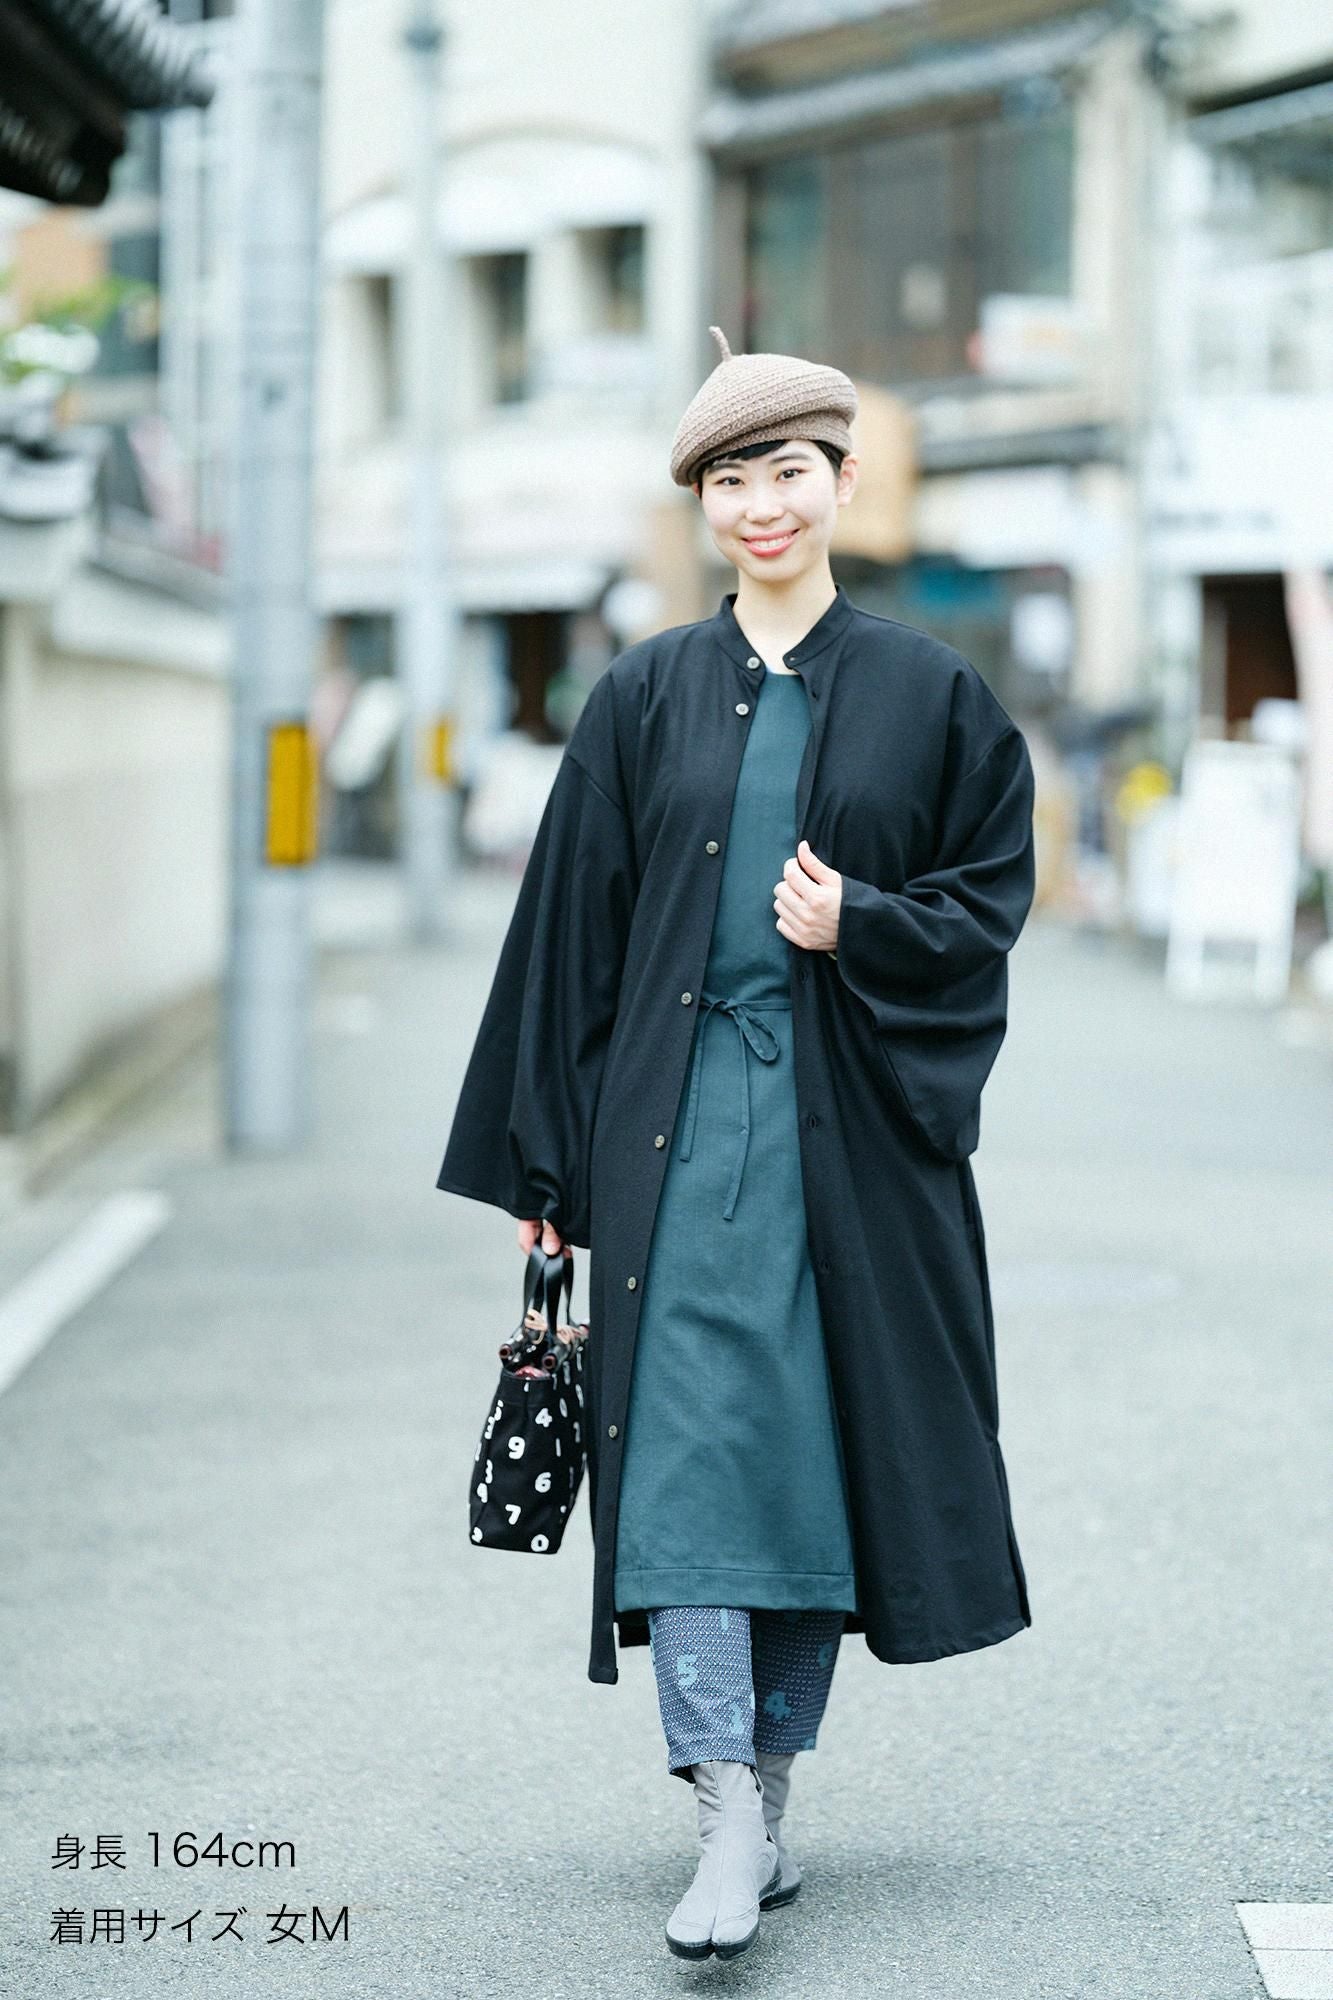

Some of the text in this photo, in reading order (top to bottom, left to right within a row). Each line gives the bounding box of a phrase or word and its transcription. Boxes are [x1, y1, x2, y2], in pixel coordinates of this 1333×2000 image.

[535, 1407, 553, 1428] 4
[508, 1436, 526, 1460] 9
[534, 1472, 551, 1493] 6
[505, 1503, 522, 1525] 7
[677, 1653, 699, 1687] 5
[763, 1690, 792, 1720] 4
